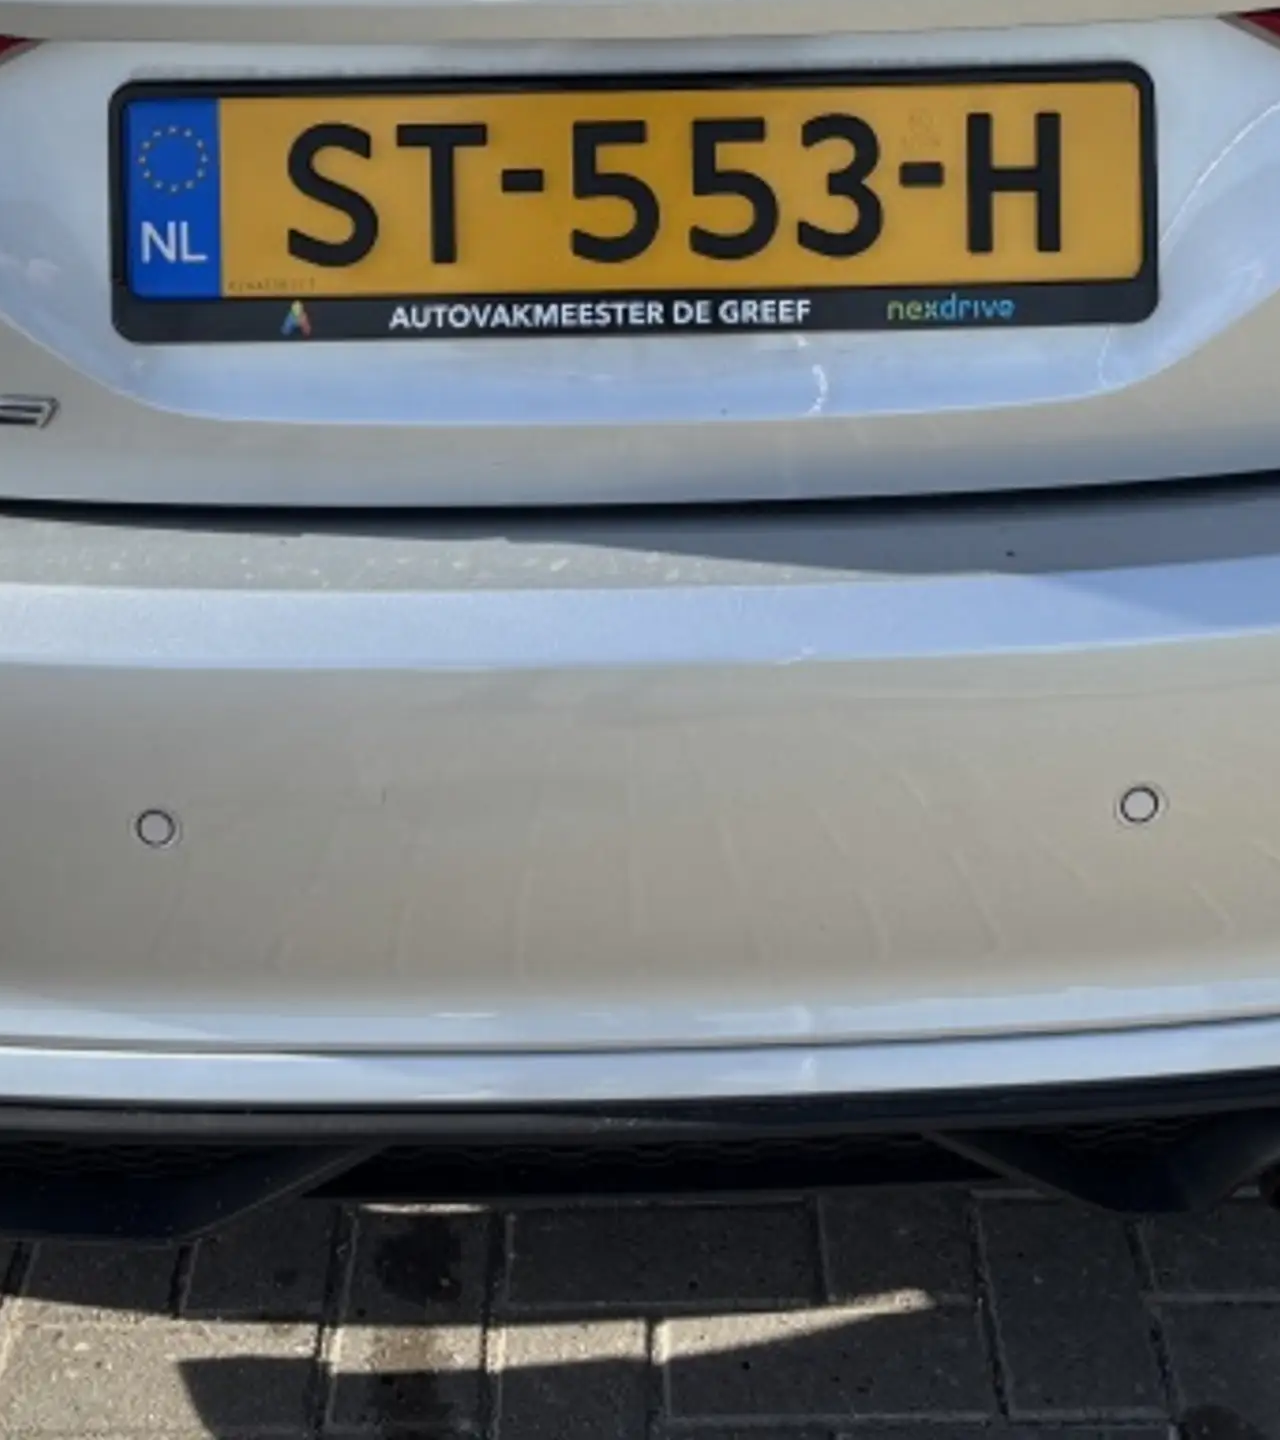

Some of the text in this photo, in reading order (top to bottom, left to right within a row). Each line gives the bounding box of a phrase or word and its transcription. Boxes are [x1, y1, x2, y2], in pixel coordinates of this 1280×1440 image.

[286, 111, 1063, 268] ST-553-H
[141, 221, 208, 264] NL
[388, 298, 812, 330] AUTOVAKMEESTER DE GREEF
[886, 292, 1016, 321] nexdrive
